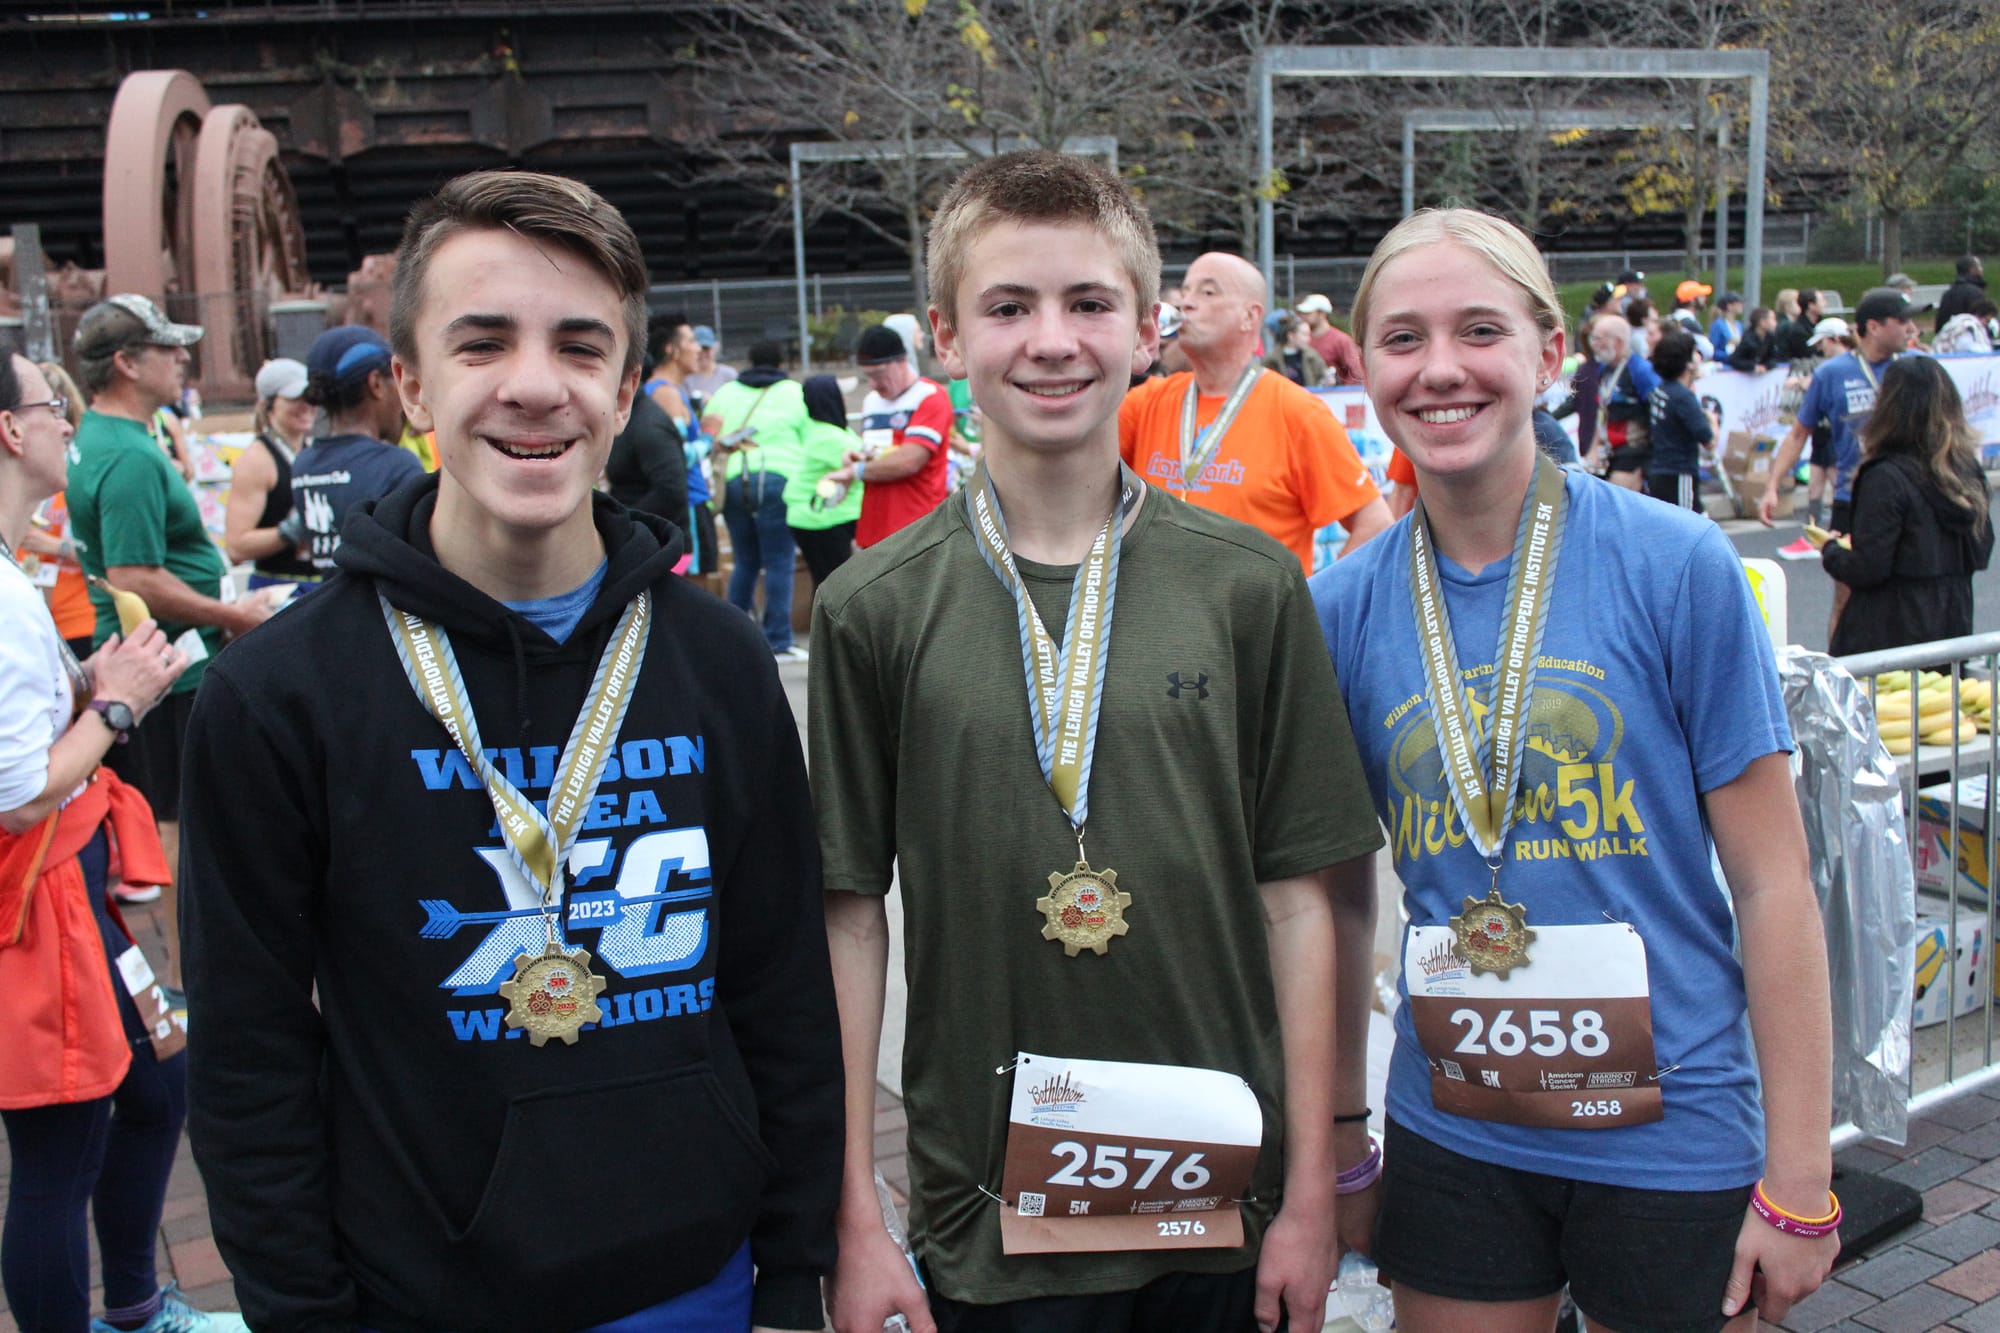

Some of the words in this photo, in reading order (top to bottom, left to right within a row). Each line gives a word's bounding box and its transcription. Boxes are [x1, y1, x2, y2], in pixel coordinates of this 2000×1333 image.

[976, 489, 987, 514] THE
[1536, 502, 1553, 521] 5K
[980, 510, 1005, 553] LEHIGH
[1414, 525, 1423, 550] THE
[1524, 521, 1549, 585] INSTITUTE
[1416, 550, 1430, 593] LEHIGH
[1080, 557, 1103, 639] ORTHOPEDIC
[1421, 592, 1439, 635] VALLEY
[1508, 586, 1536, 669] ORTHOPEDIC
[410, 630, 452, 716] ORTHOPEDIC
[1036, 638, 1055, 685] VALLEY
[1072, 641, 1093, 686] VALLEY
[1429, 636, 1456, 714] ORTHOPEDIC
[1384, 693, 1423, 730] Wilson
[1537, 656, 1605, 681] Education
[1501, 669, 1520, 715] VALLEY
[554, 795, 576, 825] THE
[566, 745, 596, 797] LEHIGH
[586, 695, 614, 745] VALLEY
[606, 615, 643, 698] ORTHOPEDIC
[1065, 690, 1085, 738] LEHIGH
[1060, 740, 1078, 766] THE
[1446, 714, 1474, 780] INSTITUTE
[1496, 718, 1513, 765] LEHIGH
[1464, 779, 1482, 800] 5K
[1496, 767, 1507, 791] THE
[507, 814, 530, 837] 5K
[1515, 839, 1570, 861] RUN
[1572, 838, 1649, 862] WALK
[569, 900, 615, 920] 2023
[1080, 894, 1096, 903] 5K
[550, 977, 567, 988] 5K
[1450, 1008, 1610, 1057] 2658
[1481, 1070, 1501, 1089] 5K
[1571, 1100, 1622, 1117] 2658
[1046, 1140, 1211, 1191] 2576
[1069, 1200, 1091, 1215] 5K
[1157, 1220, 1206, 1236] 2576
[1752, 1198, 1770, 1218] LOVE
[1794, 1228, 1819, 1236] FAITH
